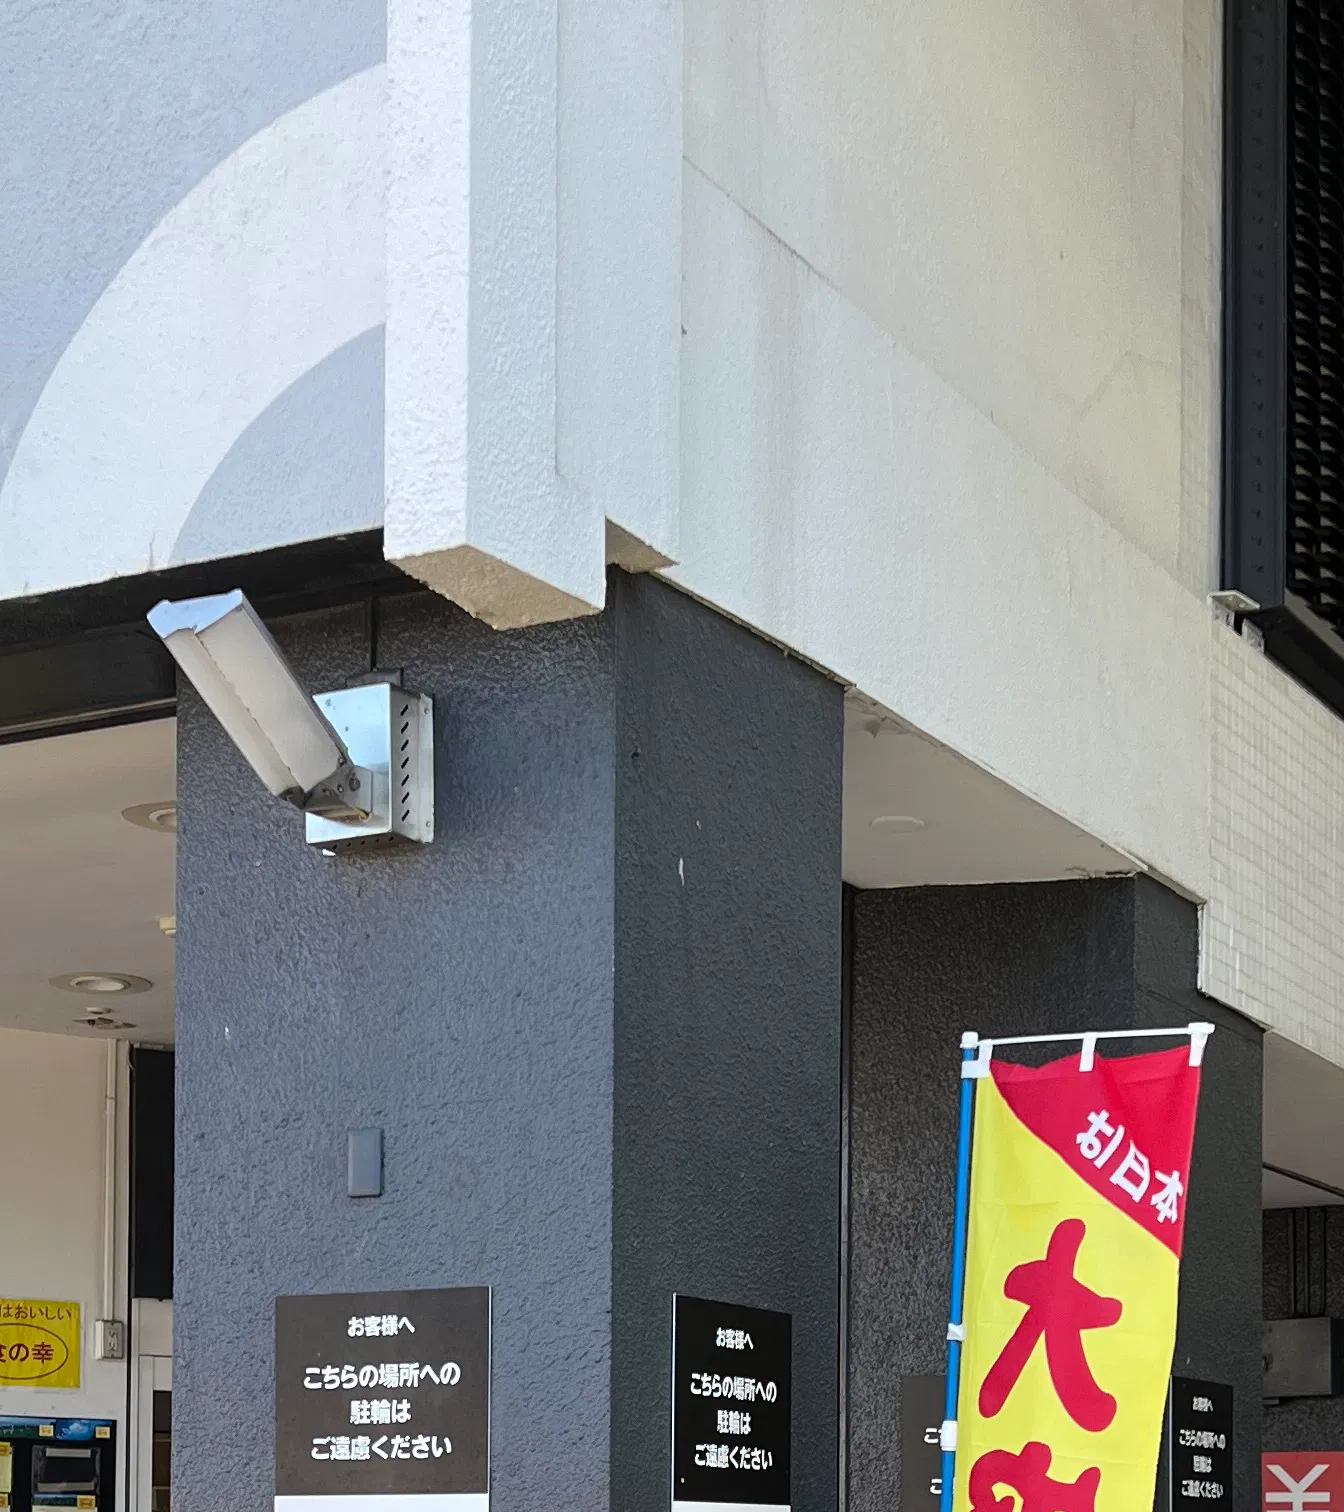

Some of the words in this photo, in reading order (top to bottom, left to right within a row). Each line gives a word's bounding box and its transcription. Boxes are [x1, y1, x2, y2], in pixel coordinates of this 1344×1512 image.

[348, 1314, 416, 1338] お客様へ
[716, 1327, 754, 1351] お客様へ
[303, 1362, 461, 1390] こちらの場所への
[690, 1372, 777, 1404] こちらの場所への
[349, 1399, 411, 1425] 駐輪は
[717, 1410, 752, 1435] 駐輪は
[310, 1434, 452, 1461] ご遠慮ください
[694, 1443, 773, 1471] ご遠慮ください
